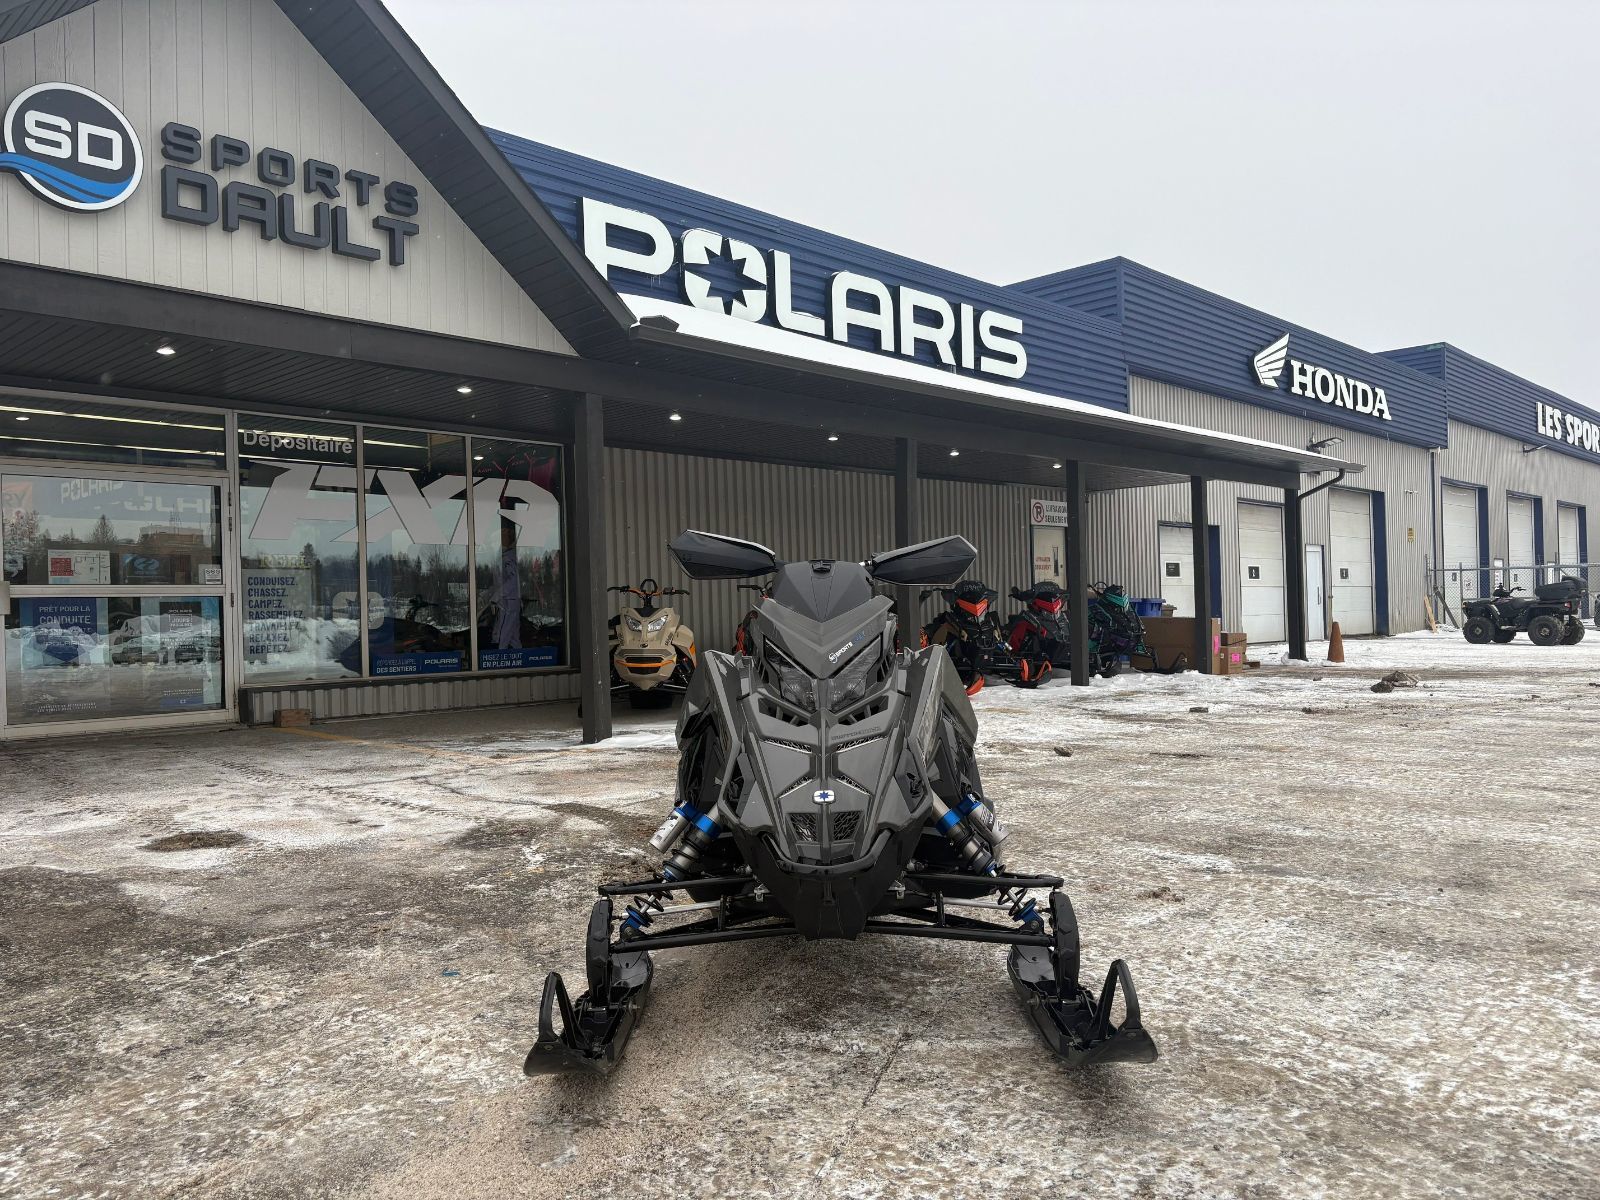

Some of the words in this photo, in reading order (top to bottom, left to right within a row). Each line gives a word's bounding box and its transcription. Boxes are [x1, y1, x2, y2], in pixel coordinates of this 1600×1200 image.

[24, 109, 123, 171] SD
[161, 121, 419, 217] SPORTS
[161, 164, 420, 266] DAULT
[580, 196, 1028, 380] POLARIS
[1289, 359, 1392, 421] HONDA
[1536, 401, 1562, 440] LES
[1564, 413, 1600, 454] SPOR
[243, 429, 354, 454] Dépositaire
[248, 576, 299, 586] CONDUISEZ.
[248, 588, 289, 597] CHASSEZ.
[248, 599, 285, 608] CAMPEZ.
[40, 615, 91, 625] CONDUITE
[389, 665, 417, 673] SENTIERS
[424, 657, 459, 665] POLARIS
